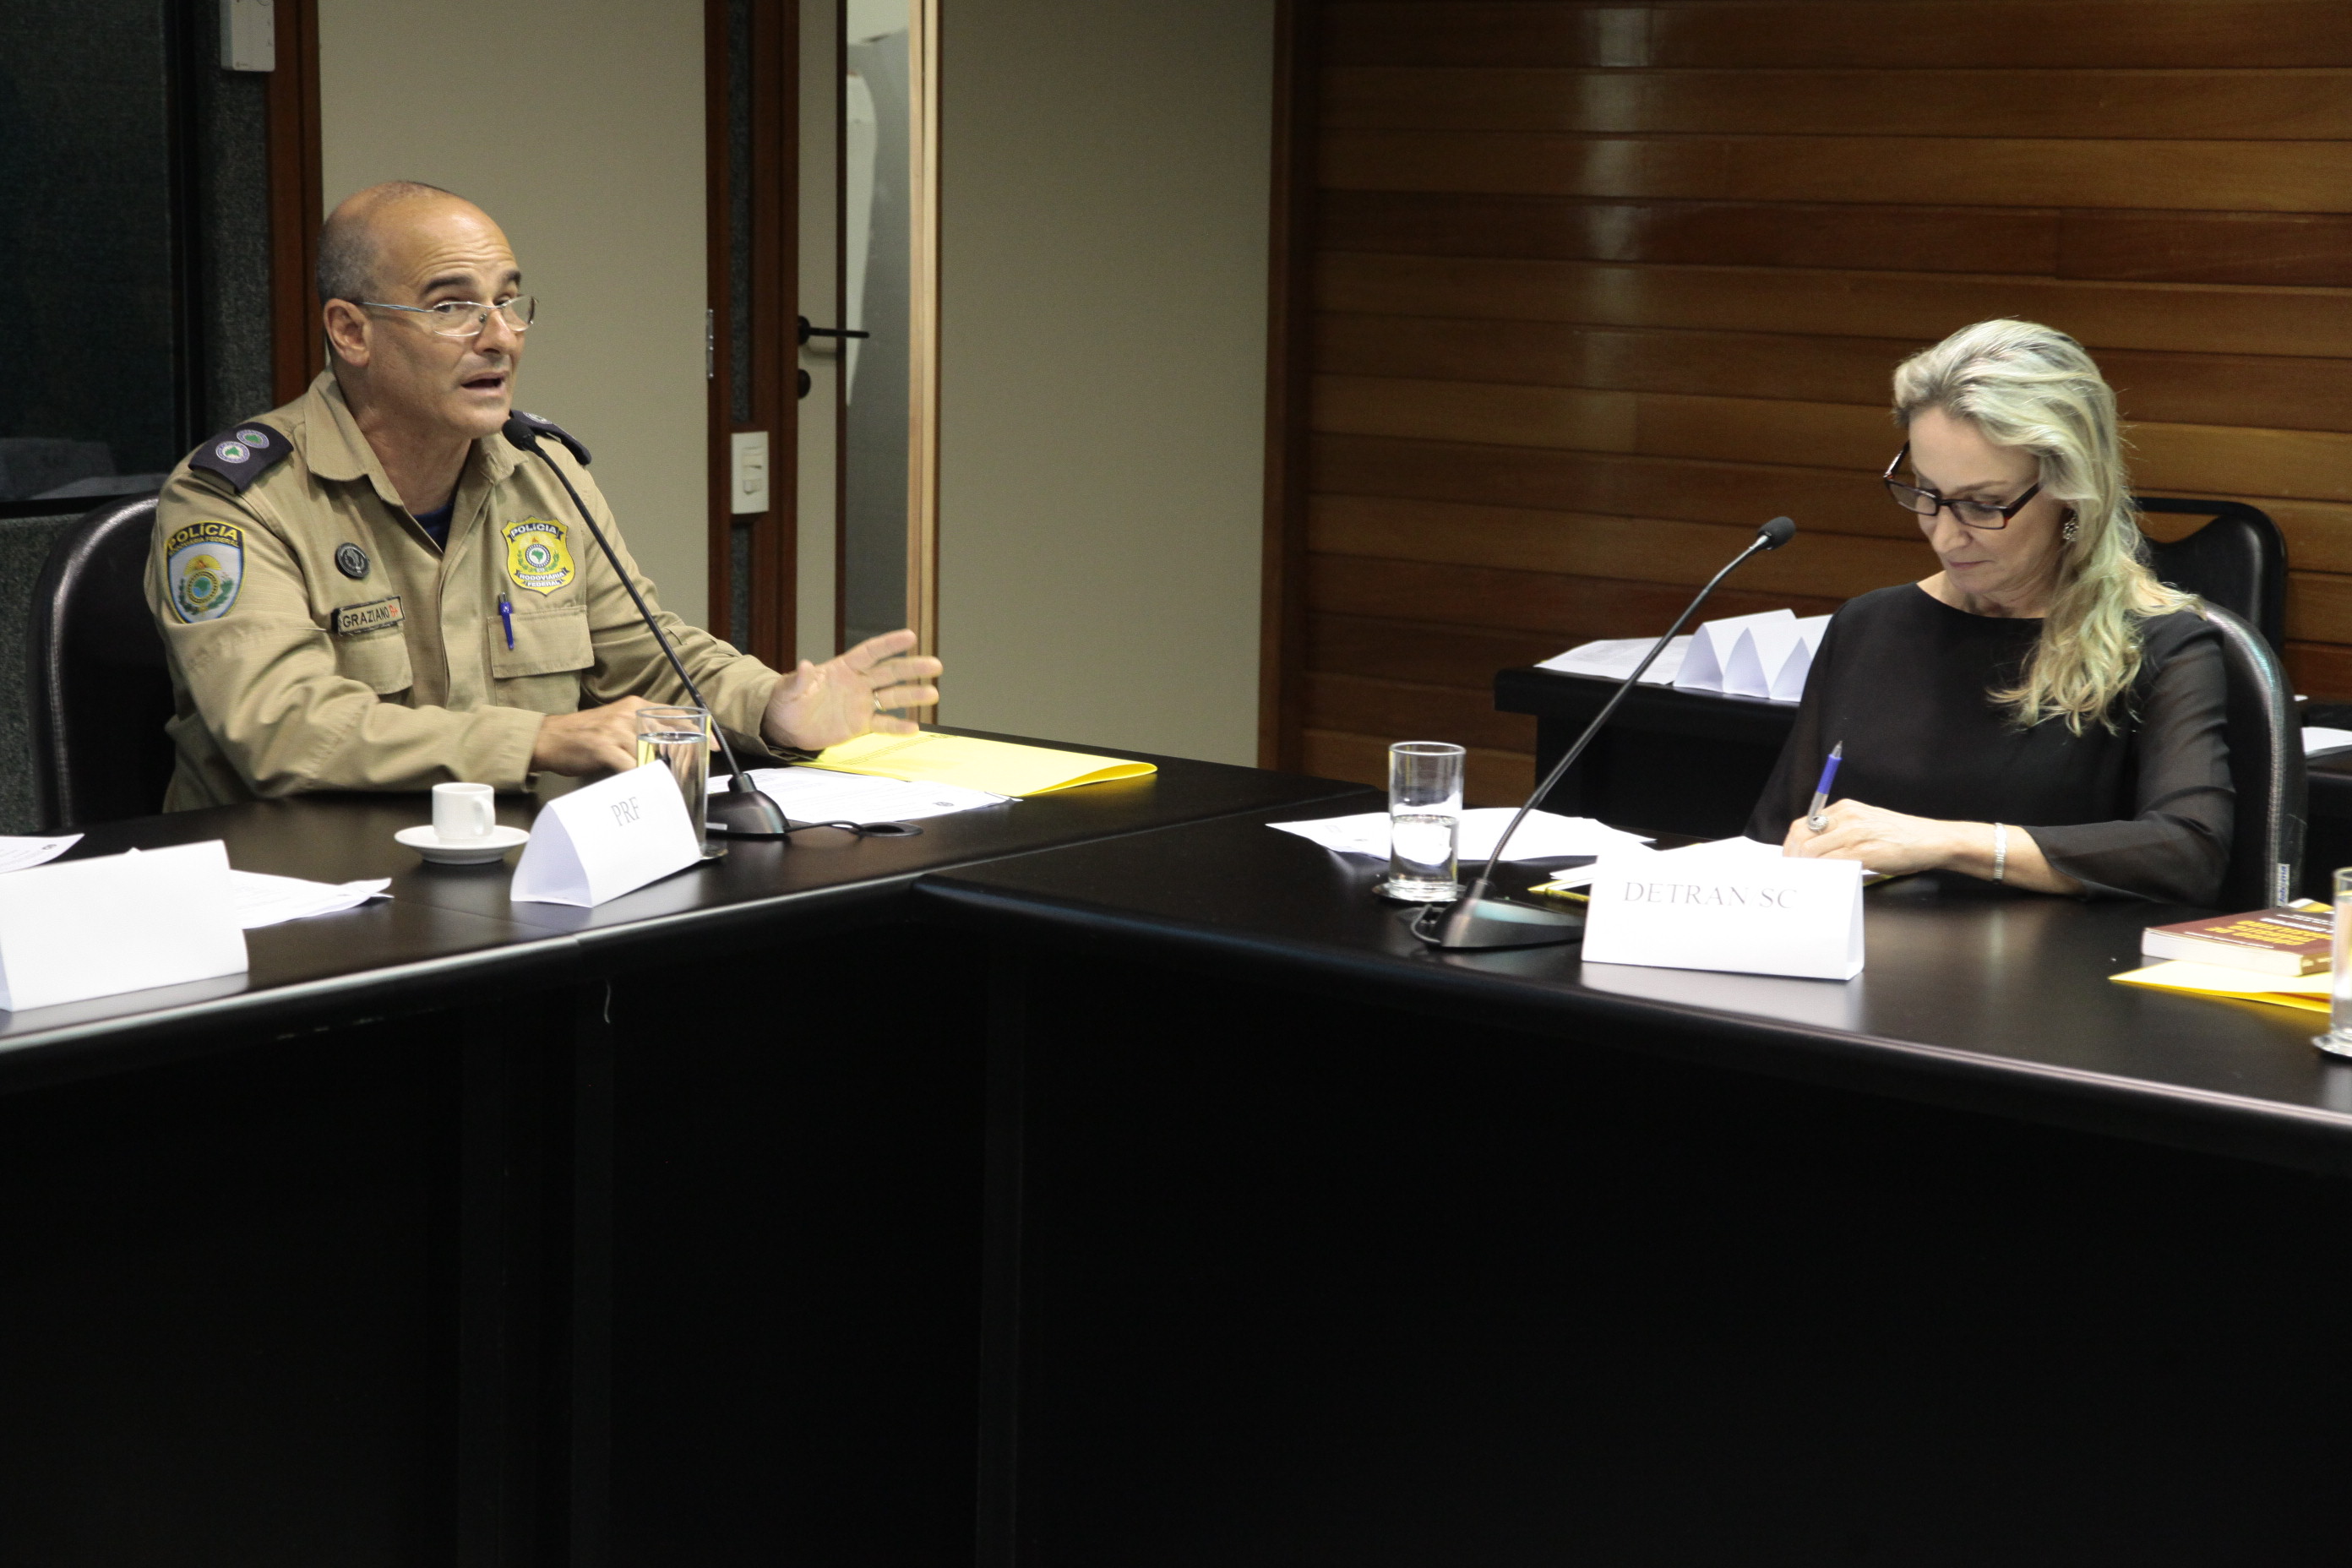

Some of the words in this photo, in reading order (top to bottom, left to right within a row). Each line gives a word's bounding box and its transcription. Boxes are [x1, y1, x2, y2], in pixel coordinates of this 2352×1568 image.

[167, 523, 238, 550] POLÍCIA
[342, 606, 390, 628] GRAZIANO
[611, 796, 640, 826] PRF
